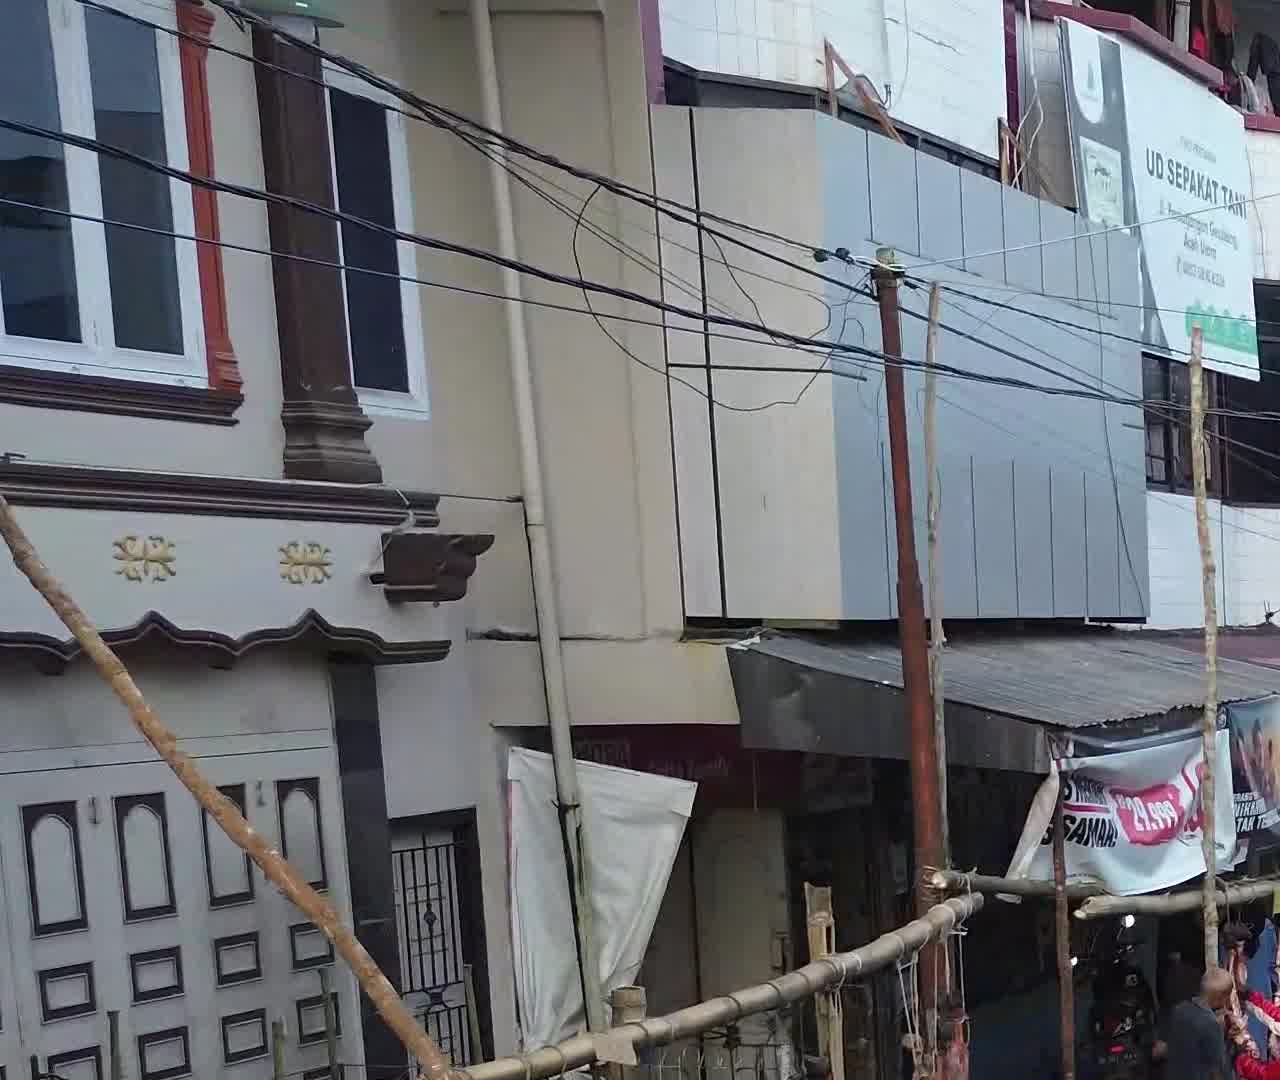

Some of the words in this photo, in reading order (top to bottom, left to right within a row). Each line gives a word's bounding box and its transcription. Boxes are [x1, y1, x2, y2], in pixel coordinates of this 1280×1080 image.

[1146, 147, 1164, 180] UD
[1167, 158, 1219, 205] SEPAKAT
[1221, 185, 1248, 220] TANI
